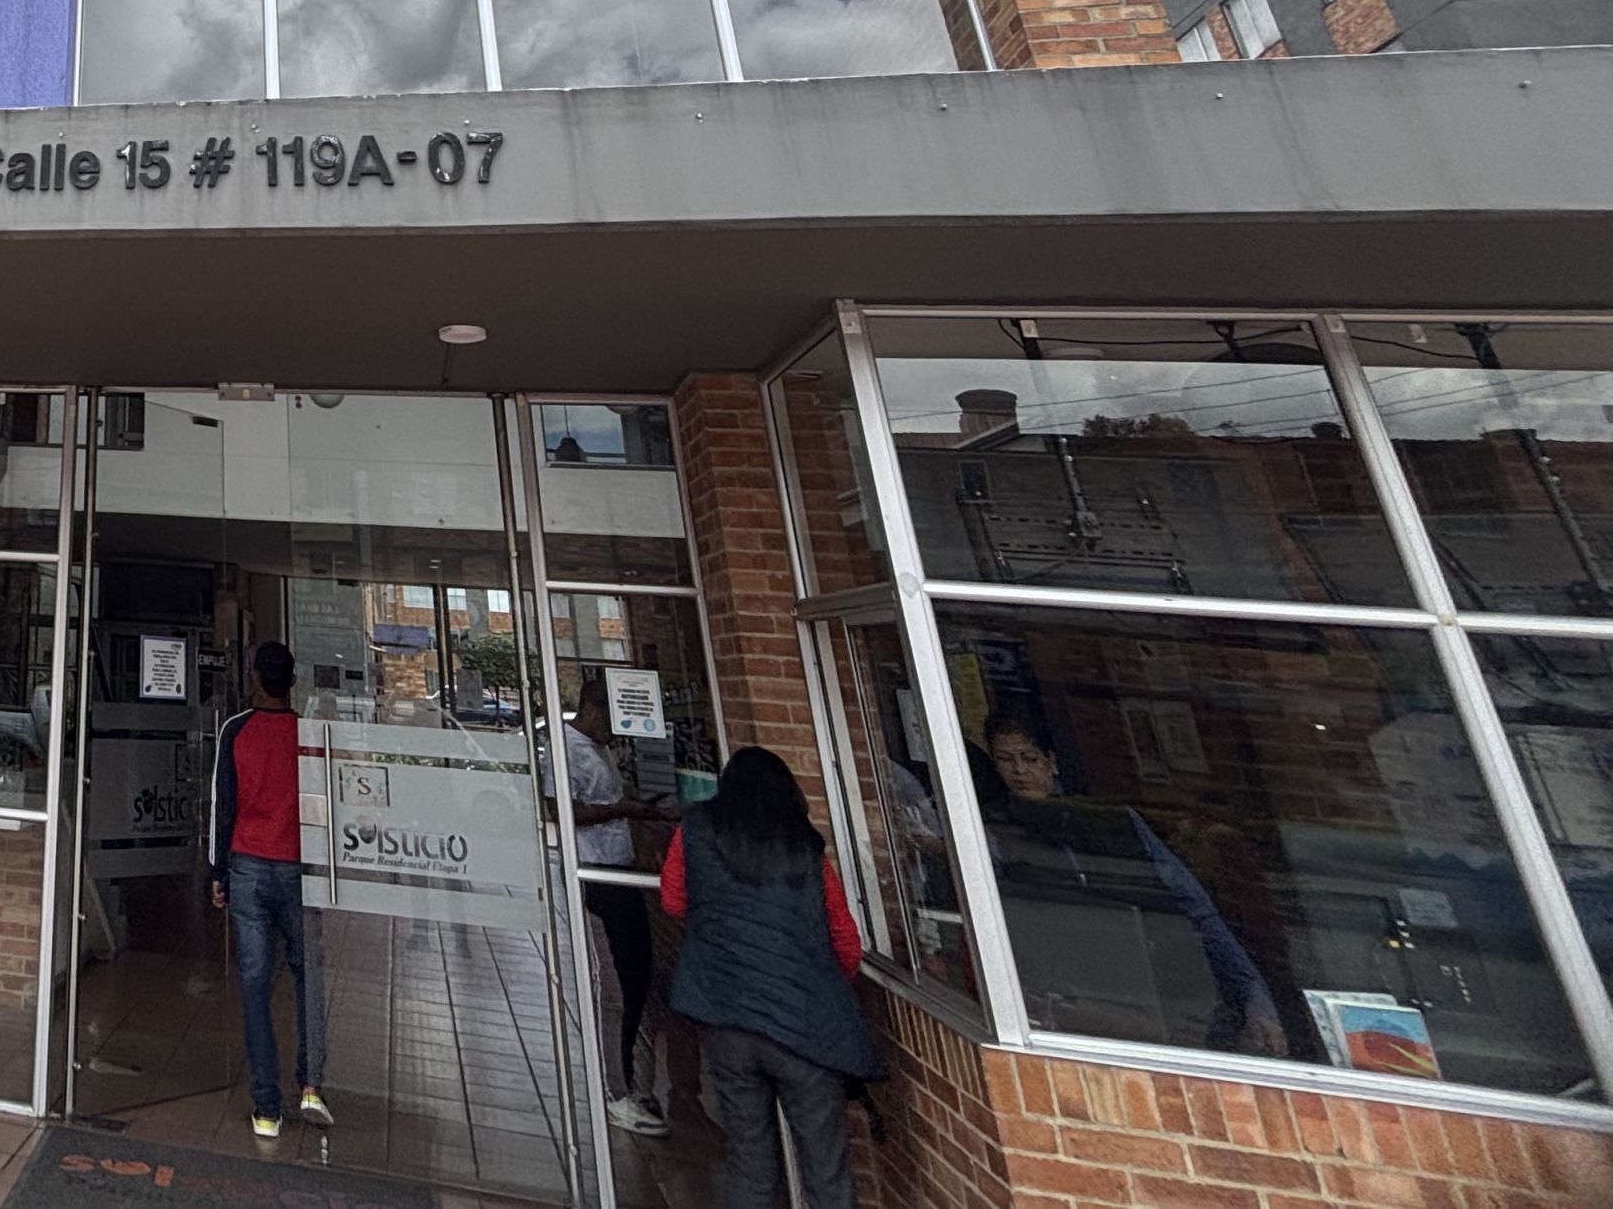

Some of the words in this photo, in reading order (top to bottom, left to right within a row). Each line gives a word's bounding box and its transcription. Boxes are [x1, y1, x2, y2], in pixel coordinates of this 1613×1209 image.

[116, 139, 171, 189] 15
[188, 136, 236, 188] #
[255, 131, 504, 187] 119A-07
[343, 851, 375, 865] Parque
[377, 855, 430, 870] Residencial
